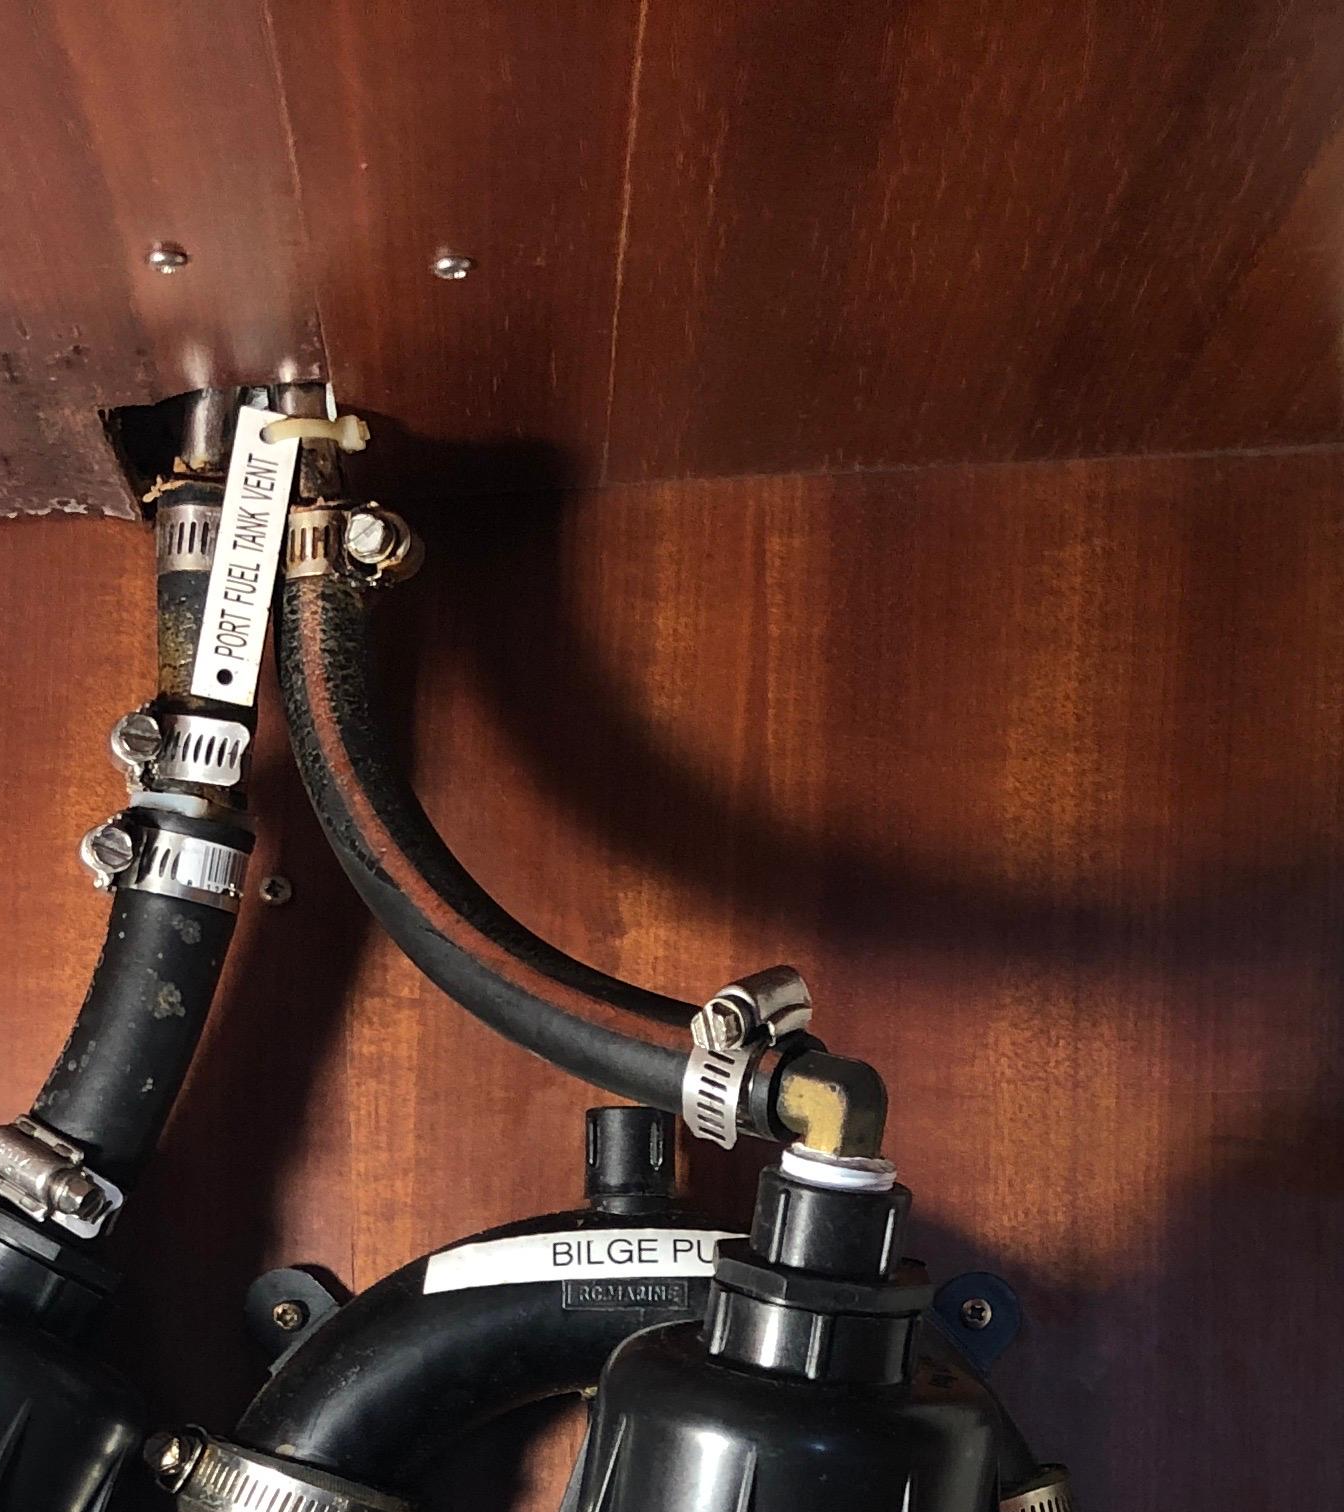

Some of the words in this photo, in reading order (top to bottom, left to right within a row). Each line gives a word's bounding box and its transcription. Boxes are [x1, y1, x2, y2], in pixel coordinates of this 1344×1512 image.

[241, 452, 279, 501] VENT
[232, 506, 270, 552] TANK
[223, 563, 260, 606] FUEL
[214, 608, 251, 661] PORT
[552, 1239, 659, 1267] BILGE
